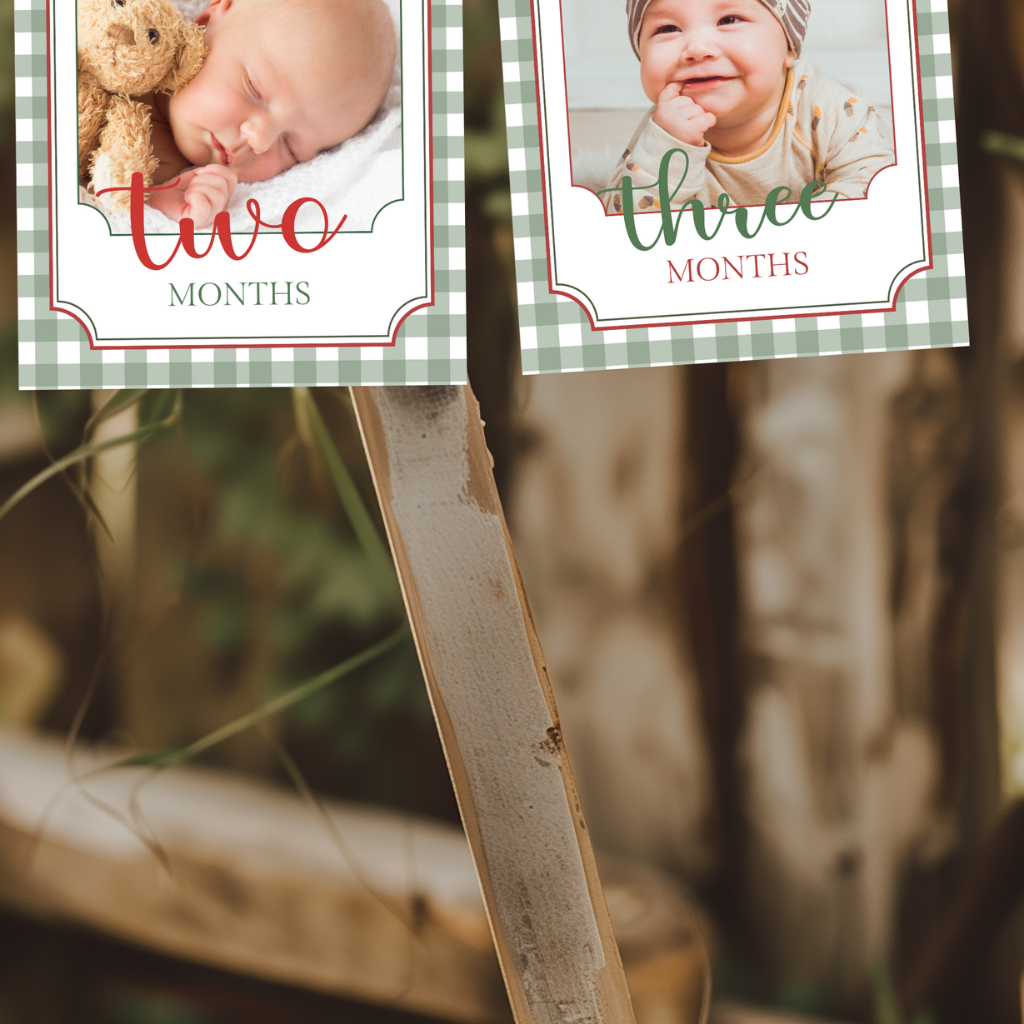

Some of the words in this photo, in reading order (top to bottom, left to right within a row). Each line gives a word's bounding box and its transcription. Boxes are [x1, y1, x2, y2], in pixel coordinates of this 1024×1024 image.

[95, 171, 348, 271] two
[595, 147, 839, 252] three
[168, 281, 311, 308] MONTHS
[666, 251, 810, 284] MONTHS
